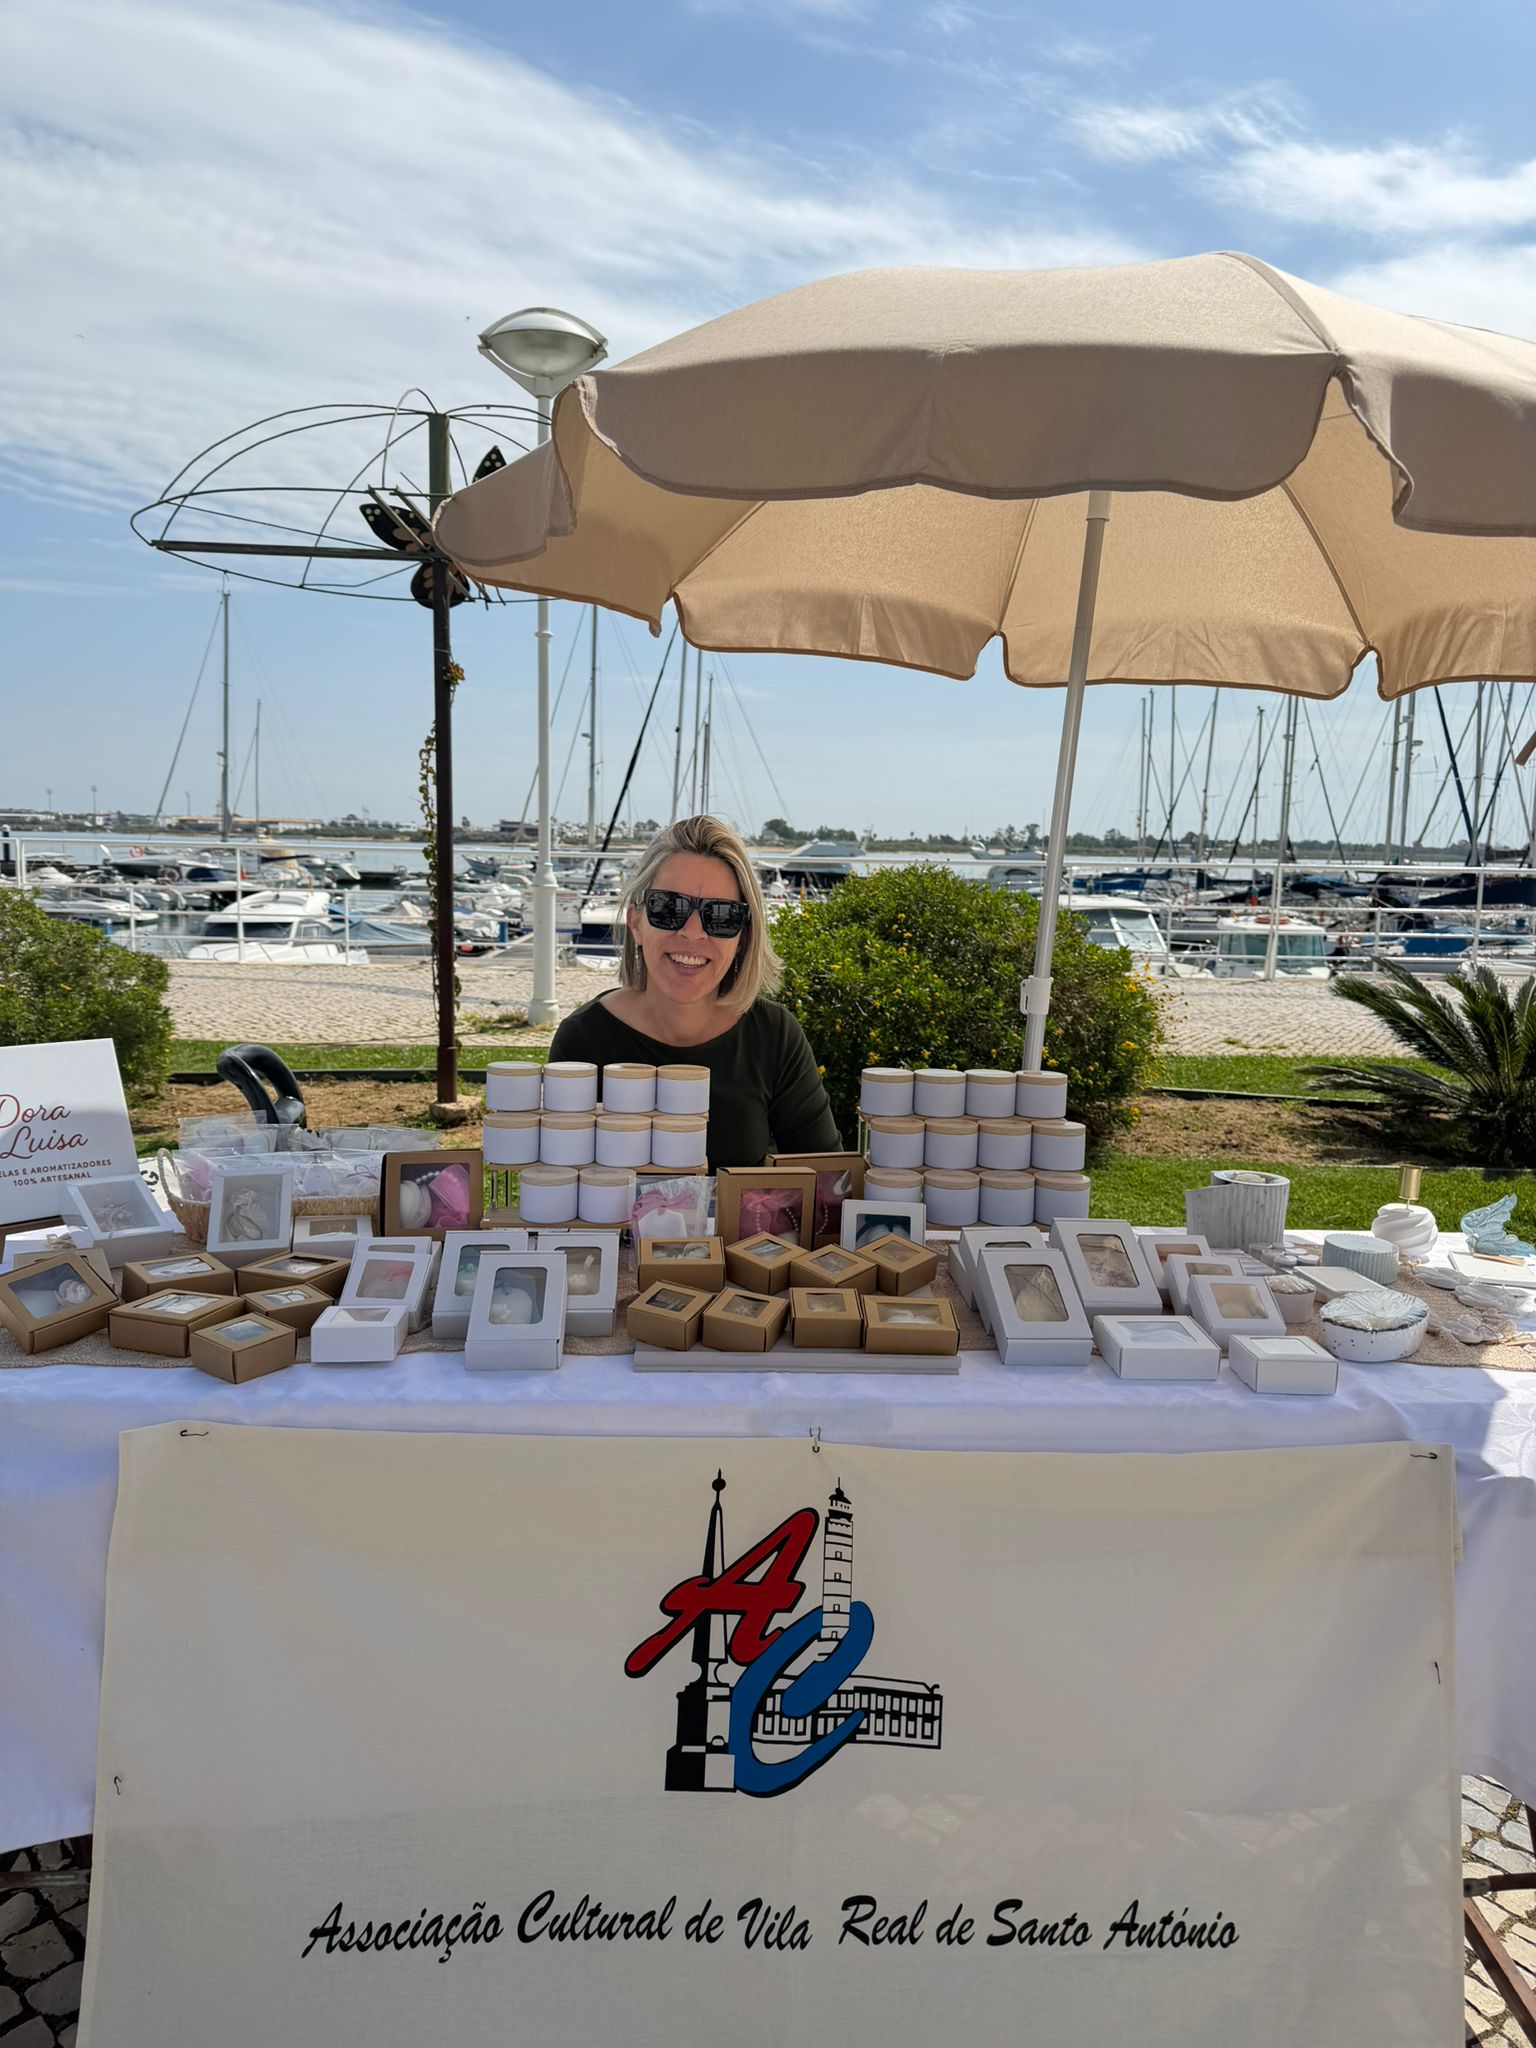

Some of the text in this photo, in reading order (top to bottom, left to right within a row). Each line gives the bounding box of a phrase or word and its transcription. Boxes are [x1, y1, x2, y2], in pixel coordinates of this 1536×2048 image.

[0, 1094, 71, 1128] Dora
[0, 1126, 89, 1159] Luisa
[13, 1171, 92, 1187] 100% ARTESANAL
[30, 1159, 112, 1174] AROMATIZADORES
[301, 1889, 1240, 1963] Associação Cultural de Vila Real de Santo António
